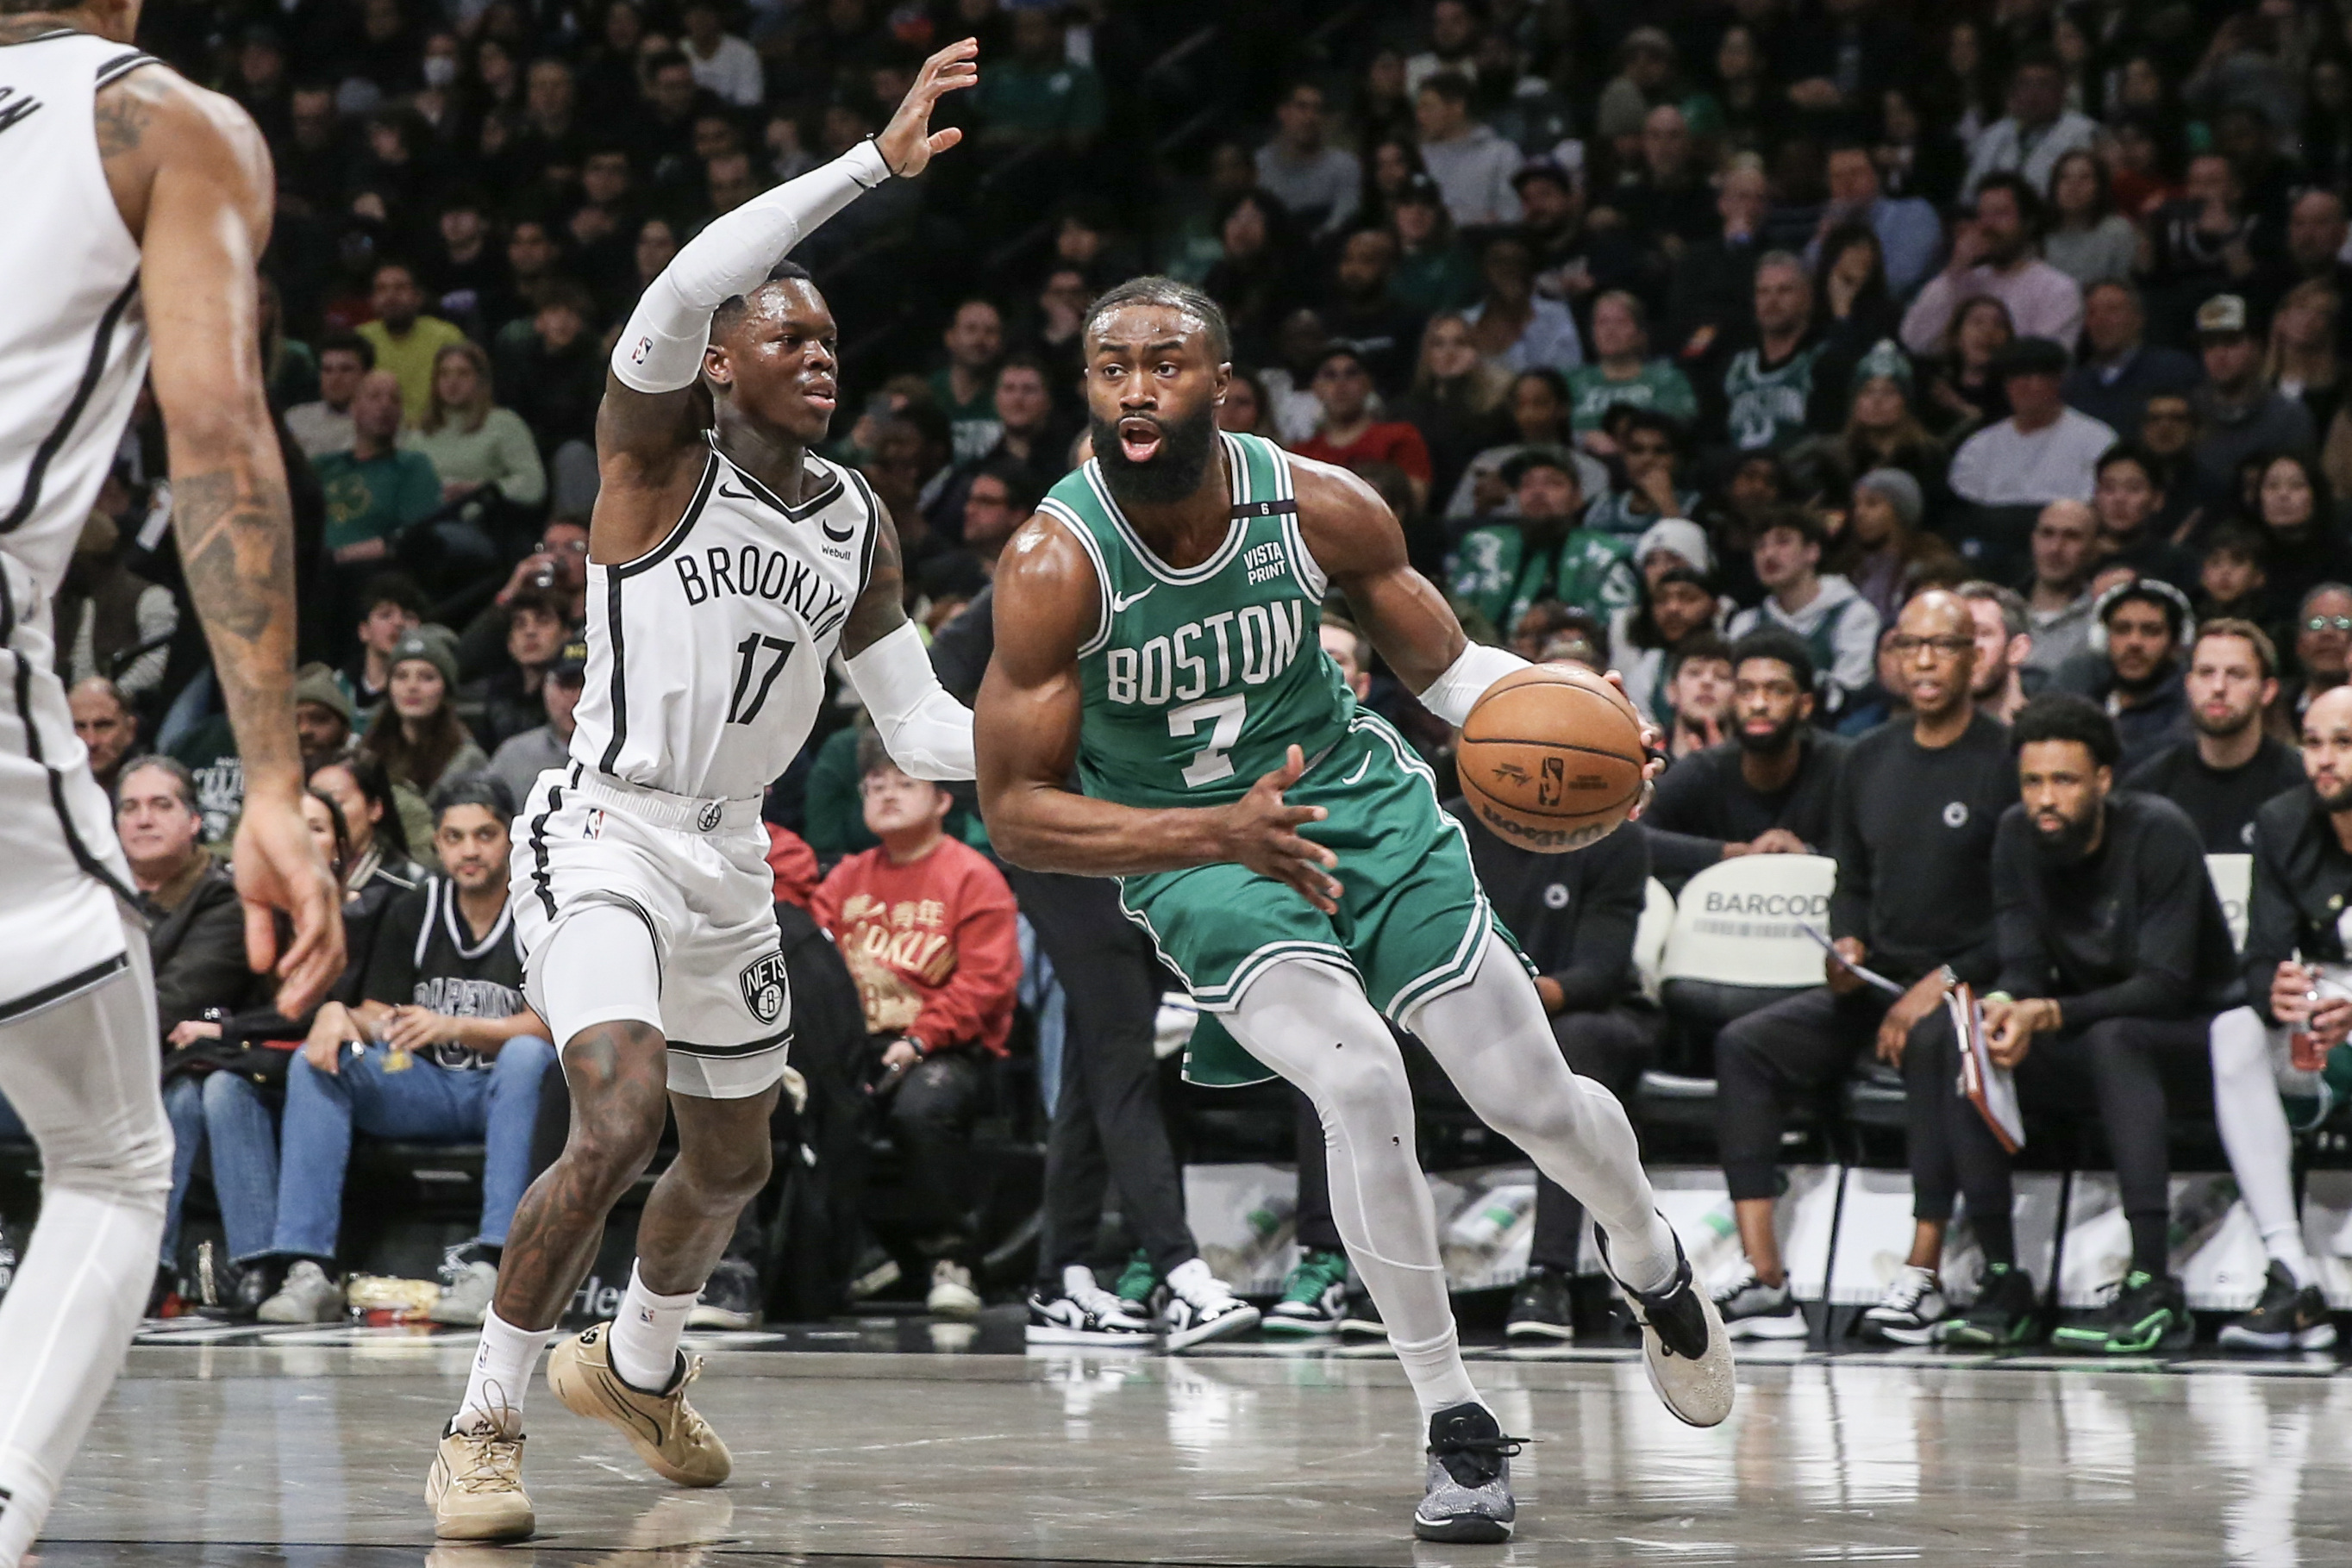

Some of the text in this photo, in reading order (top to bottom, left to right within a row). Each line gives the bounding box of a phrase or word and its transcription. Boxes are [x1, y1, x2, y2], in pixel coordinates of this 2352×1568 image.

[1260, 503, 1270, 515] 6
[821, 544, 851, 561] Webull
[1243, 541, 1285, 571] VISTA
[1248, 559, 1285, 585] PRINT
[1107, 599, 1303, 706] BOSTON
[726, 632, 797, 725] 17
[1167, 692, 1248, 789] 7
[746, 954, 786, 997] NETS
[766, 990, 776, 1015] B
